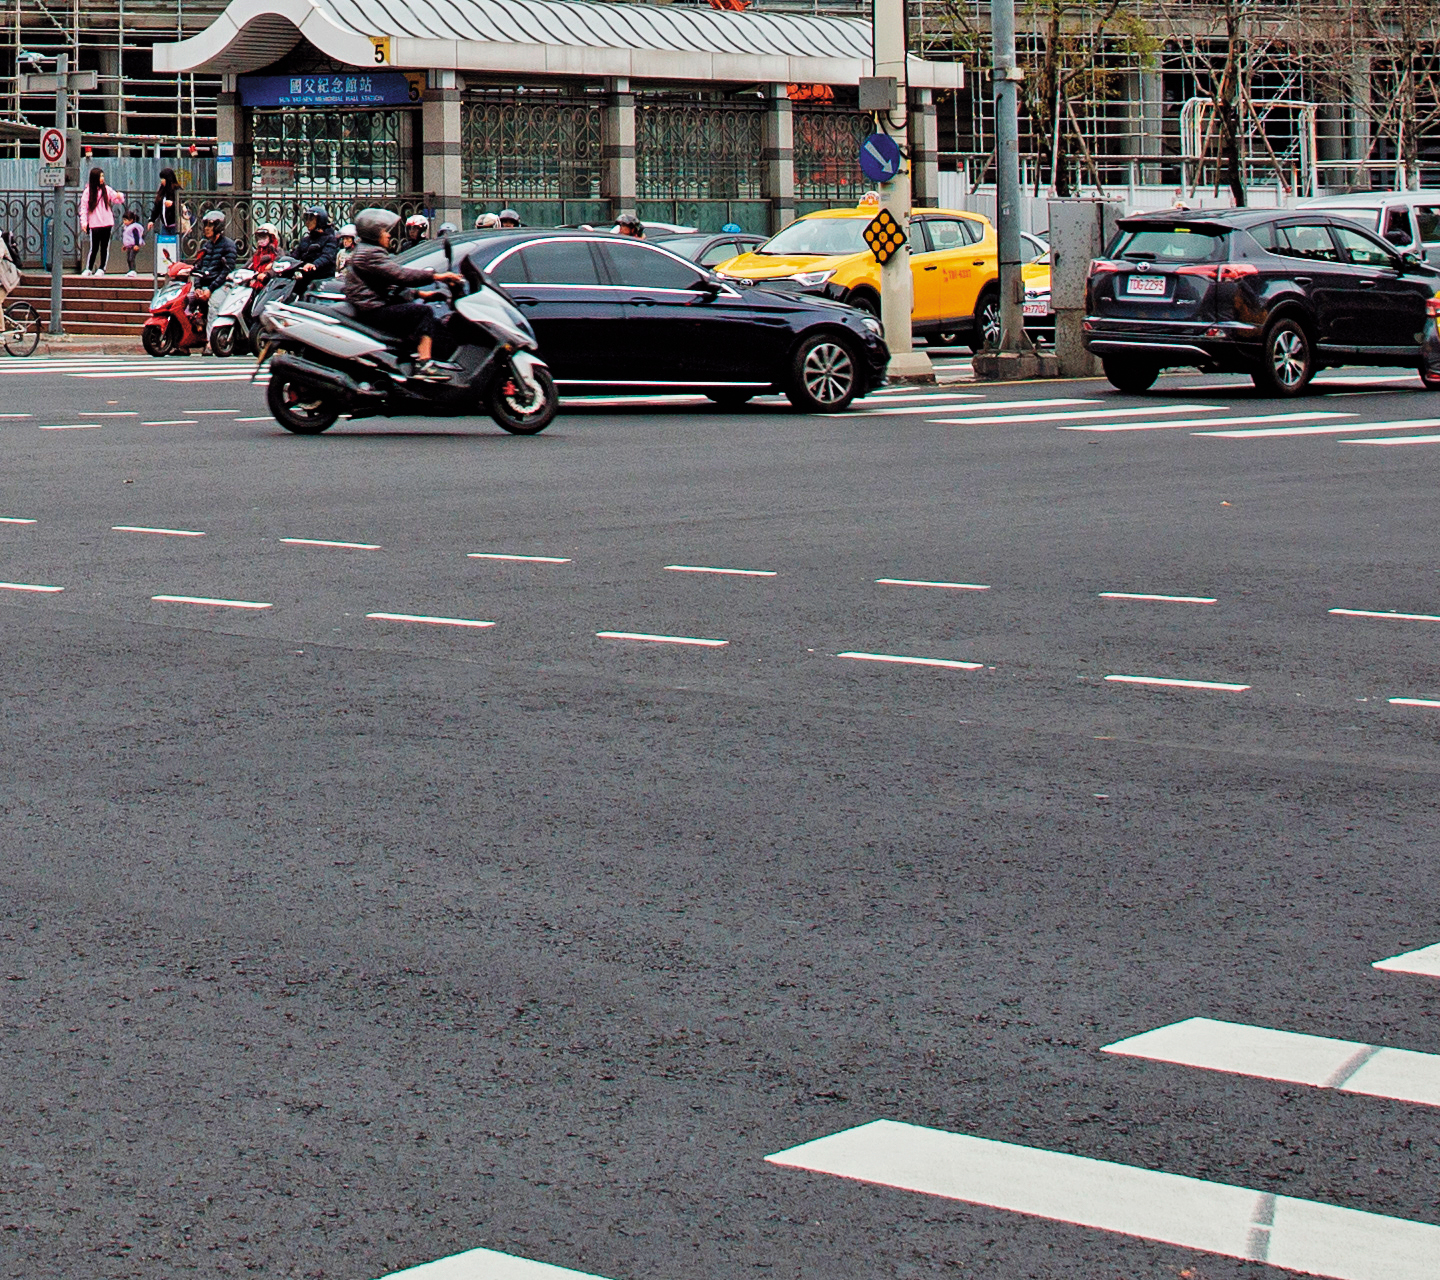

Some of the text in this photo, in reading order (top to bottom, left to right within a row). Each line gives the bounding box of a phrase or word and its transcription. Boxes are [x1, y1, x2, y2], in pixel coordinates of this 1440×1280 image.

[374, 44, 385, 63] 5
[290, 76, 372, 94] 國父紀念館站
[408, 80, 420, 101] 5
